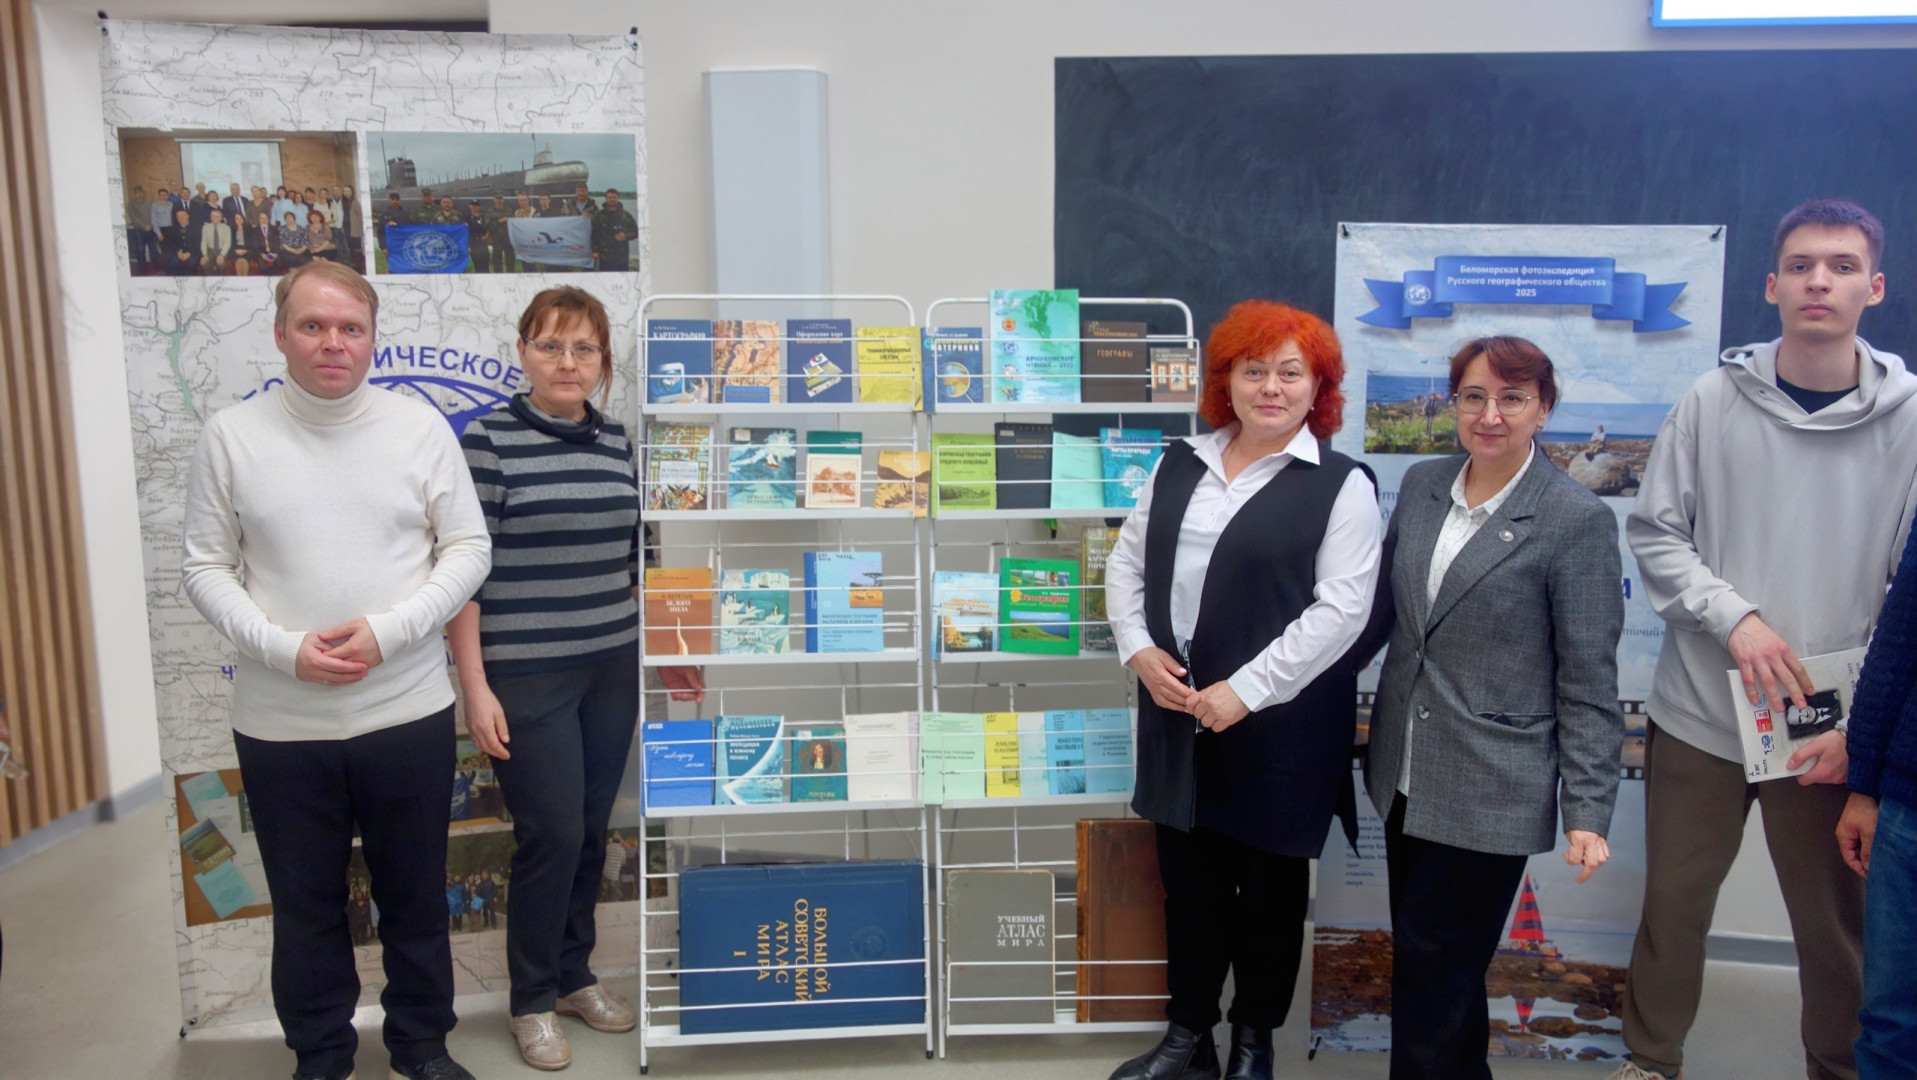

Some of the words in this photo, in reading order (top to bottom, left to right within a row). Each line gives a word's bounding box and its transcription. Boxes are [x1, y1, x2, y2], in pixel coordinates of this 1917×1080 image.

[1459, 264, 1519, 276] Беломорская
[1521, 264, 1595, 278] фотоэкспедиция
[1447, 276, 1486, 288] Русского
[1487, 277, 1563, 289] географического
[1563, 278, 1607, 288] общества
[1515, 289, 1537, 298] 2025
[1097, 349, 1134, 358] ГЕОГРАФЫ
[373, 345, 524, 390] ИЧЕСКОЕ
[1622, 627, 1665, 638] тичий»
[997, 914, 1045, 923] УЧЕБНЫЙ
[996, 924, 1046, 938] АТЛАС
[997, 938, 1045, 947] МИРА
[757, 924, 770, 981] МИРА
[775, 919, 789, 984] АТЛАС
[794, 898, 812, 1004] СОВЕТСКИЙ
[813, 907, 831, 993] БОЛЬШОЙ
